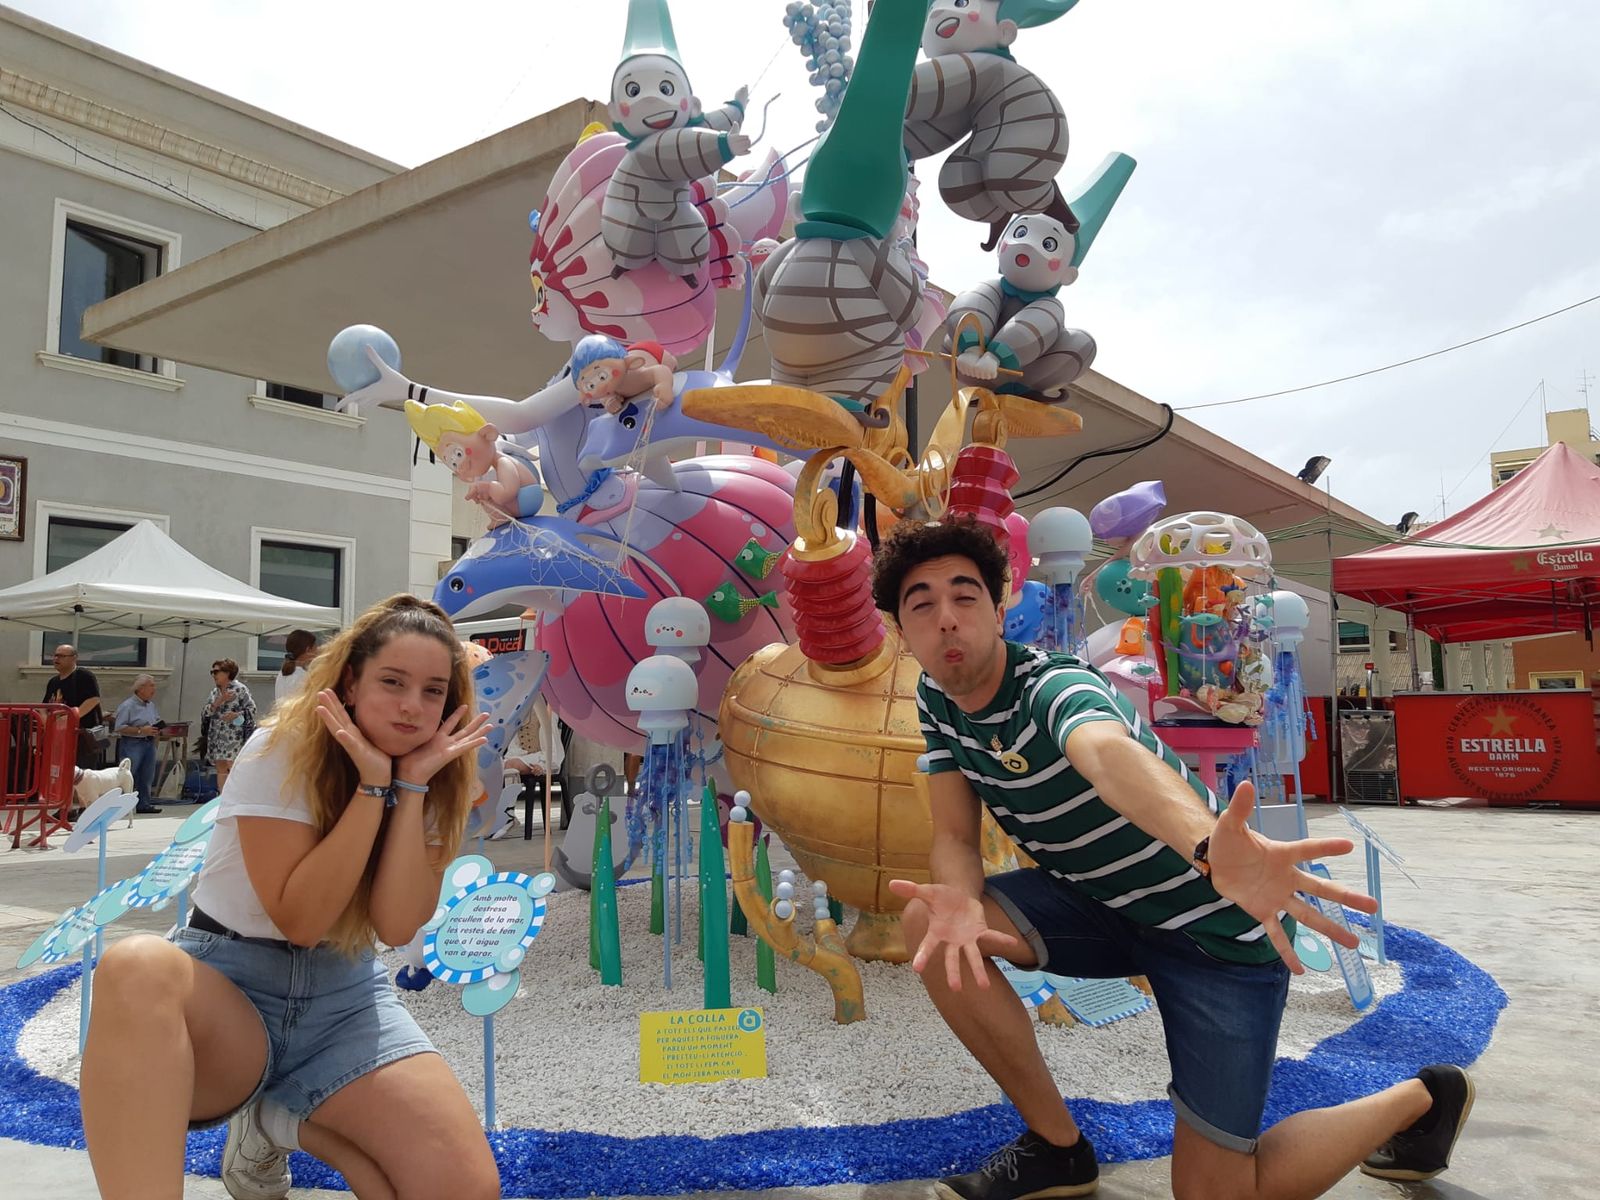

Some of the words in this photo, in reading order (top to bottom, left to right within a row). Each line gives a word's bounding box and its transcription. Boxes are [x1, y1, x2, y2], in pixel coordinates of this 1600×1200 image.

[1537, 550, 1593, 565] Estrella
[1461, 738, 1547, 752] ESTRELLA
[1489, 753, 1519, 761] DAMM
[472, 894, 492, 902] Amb
[494, 894, 518, 902] molta
[484, 915, 496, 923] de
[499, 927, 516, 935] fem
[671, 1016, 684, 1025] LA
[689, 1014, 725, 1024] COLLA
[700, 1042, 733, 1050] MOMENT
